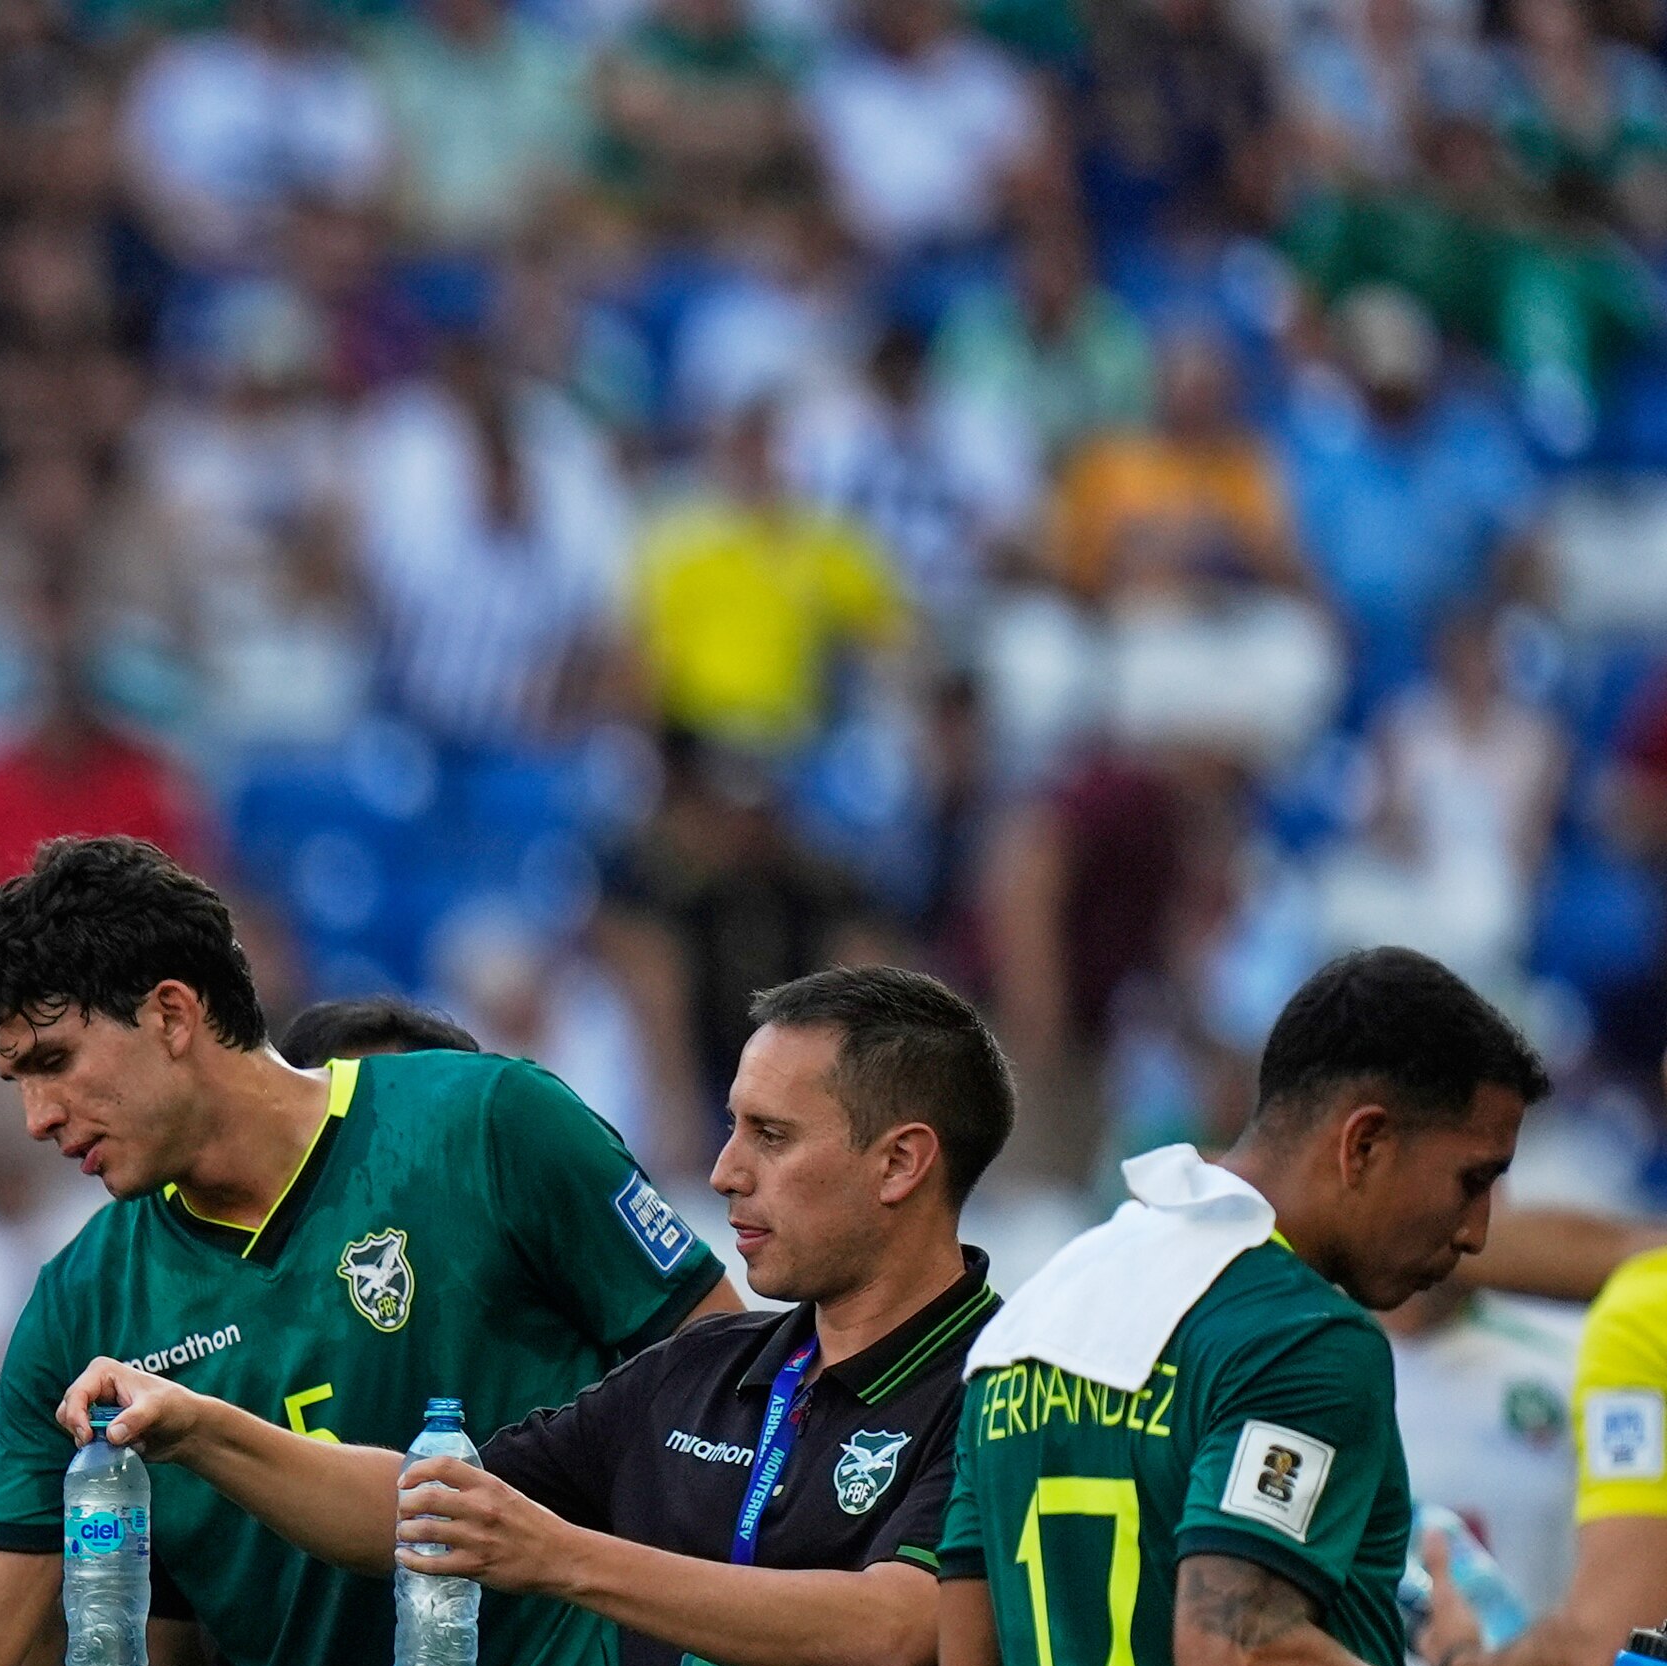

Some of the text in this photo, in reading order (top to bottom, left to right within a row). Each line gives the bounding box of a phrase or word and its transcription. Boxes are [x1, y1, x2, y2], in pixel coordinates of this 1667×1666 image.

[377, 1295, 397, 1317] FBF
[846, 1481, 871, 1504] FBF
[81, 1520, 119, 1540] ciel
